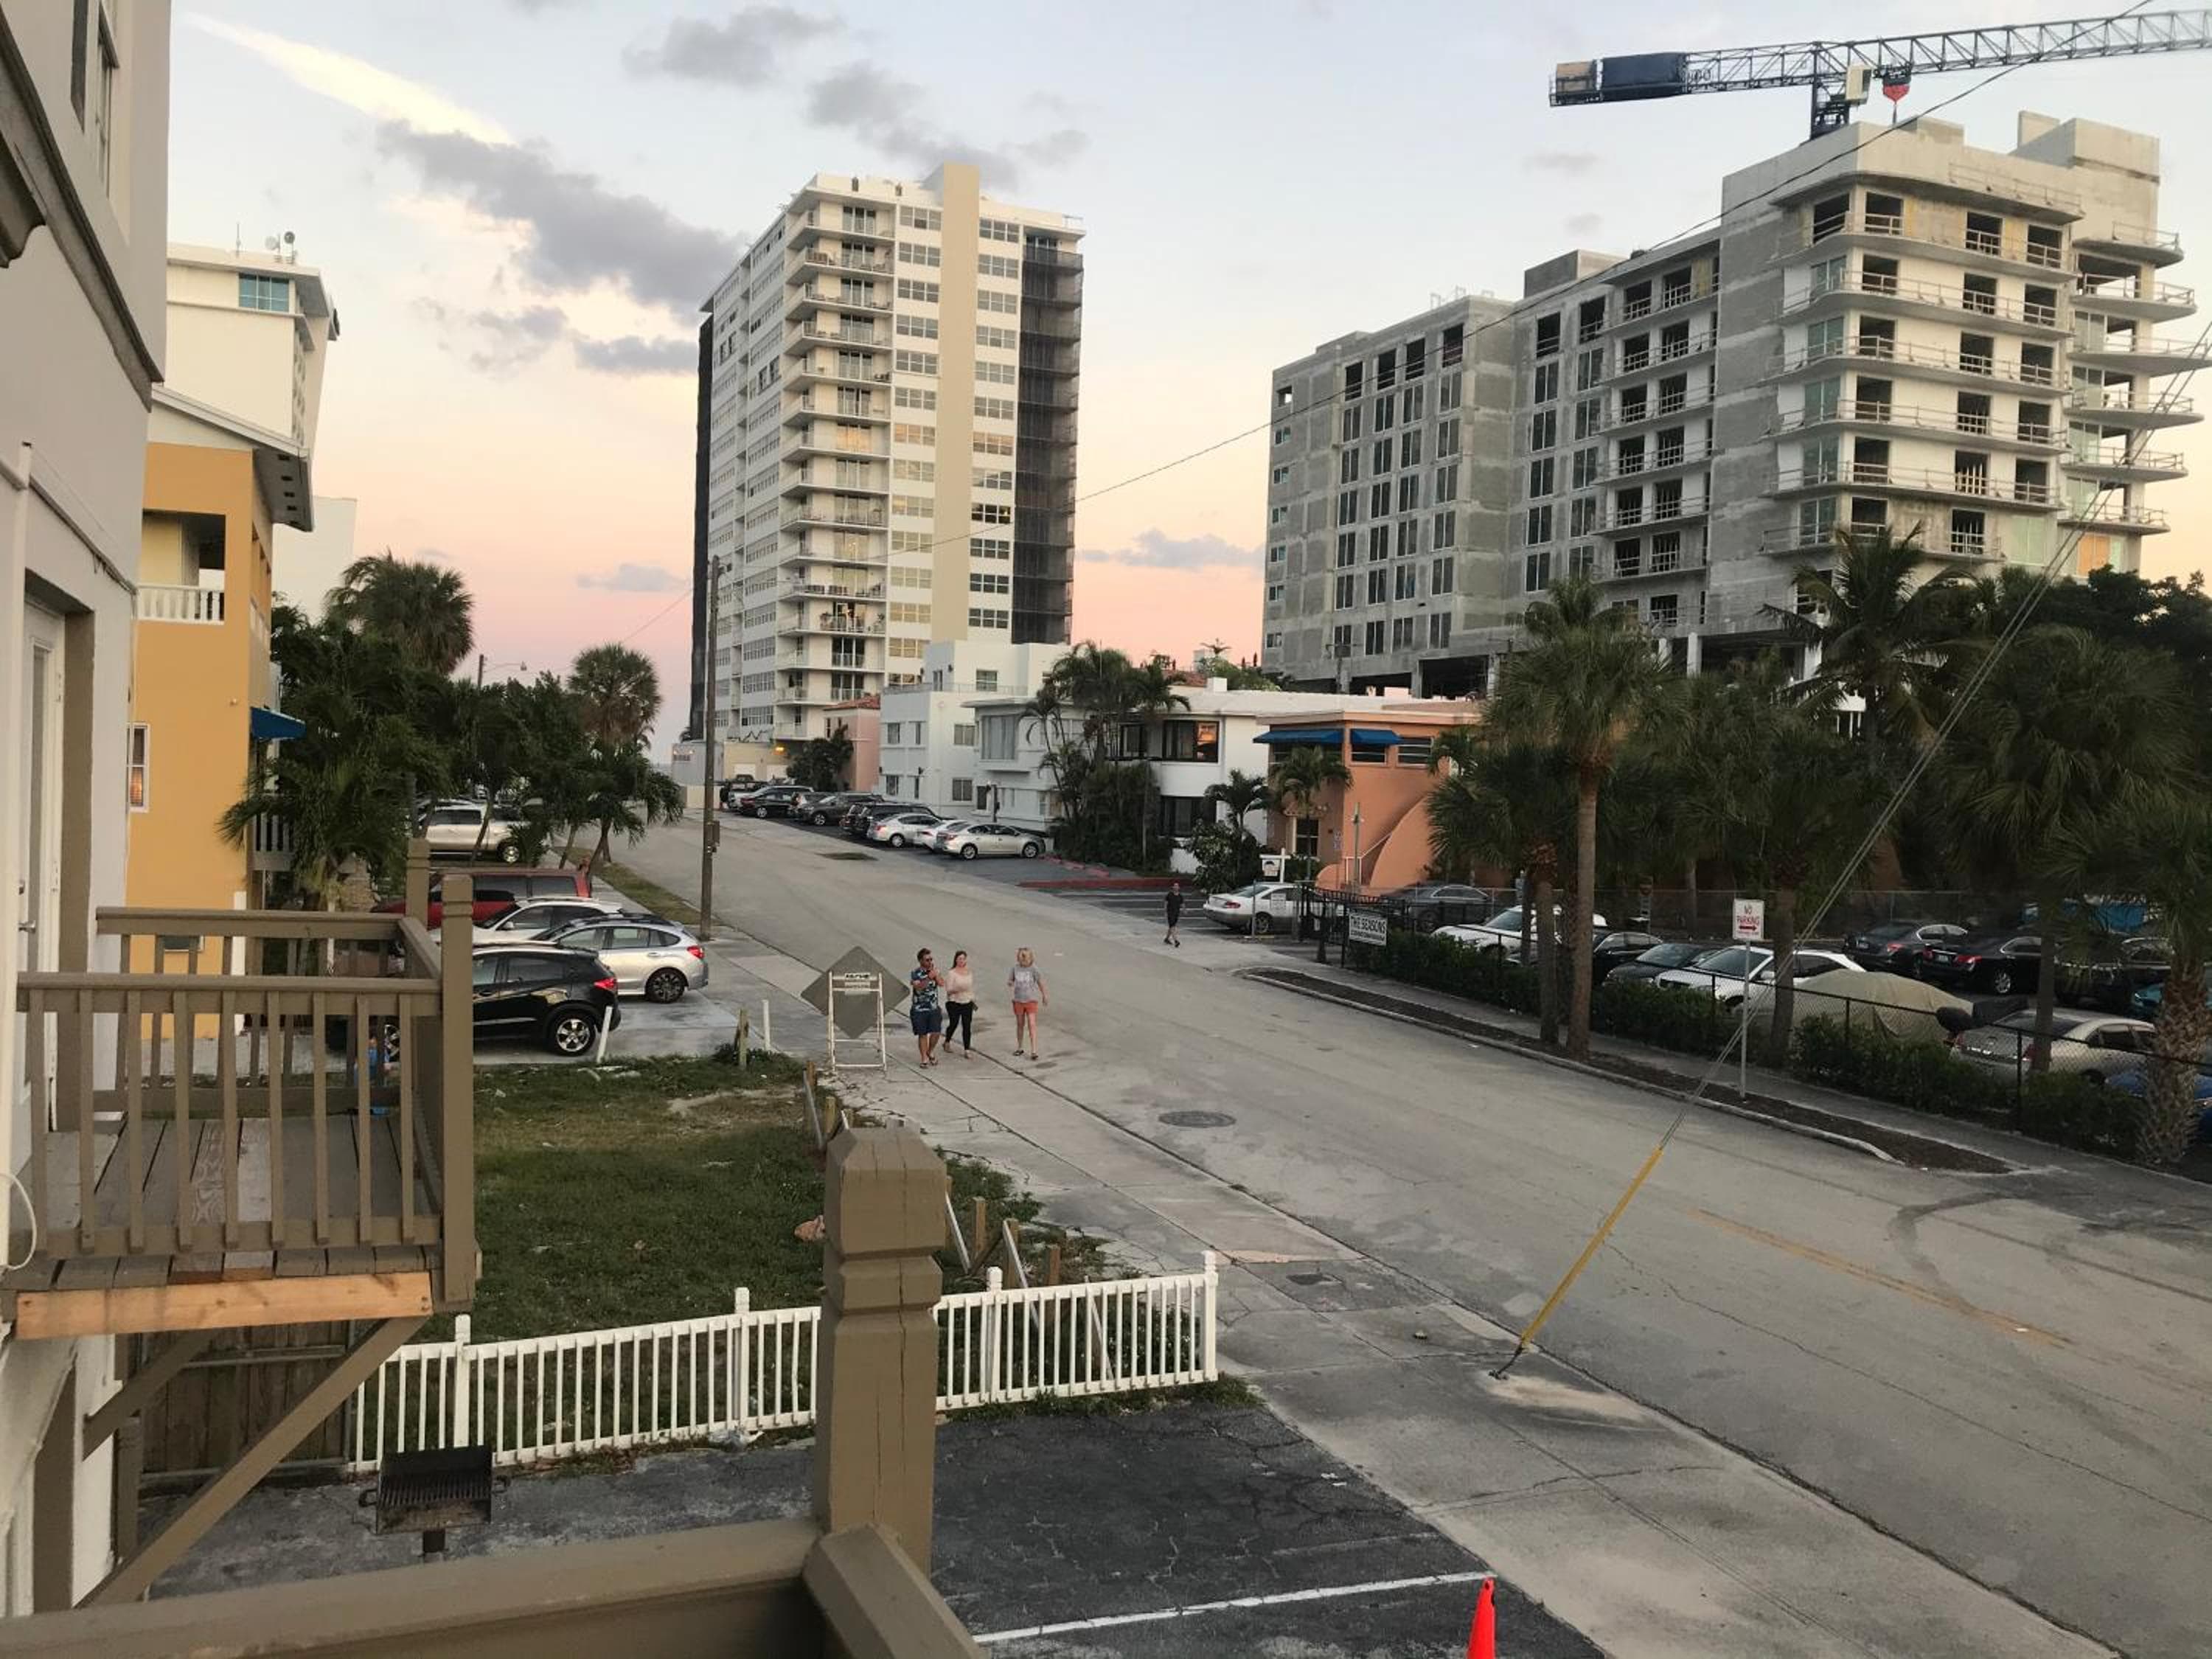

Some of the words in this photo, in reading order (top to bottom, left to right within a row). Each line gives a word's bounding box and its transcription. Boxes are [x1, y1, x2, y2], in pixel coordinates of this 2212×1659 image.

[1744, 905, 1753, 914] NO
[1351, 916, 1360, 929] THE
[1362, 918, 1385, 933] SEASONS
[1736, 915, 1760, 925] PARKING
